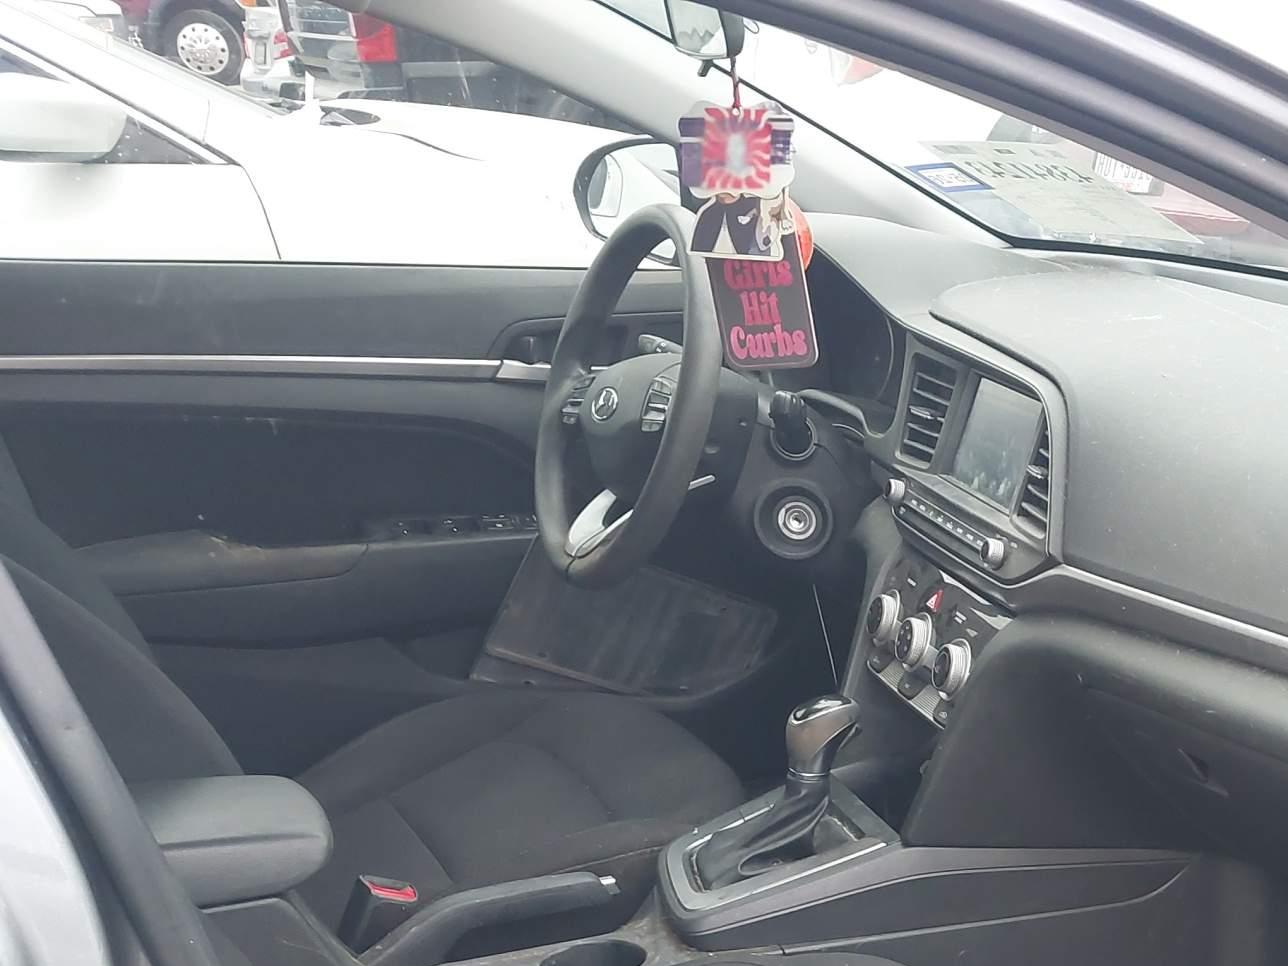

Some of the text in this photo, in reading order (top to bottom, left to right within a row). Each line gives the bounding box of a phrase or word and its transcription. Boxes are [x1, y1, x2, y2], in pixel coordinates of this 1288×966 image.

[723, 259, 794, 290] Girls
[739, 291, 782, 326] Hit
[729, 323, 809, 360] Curbs
